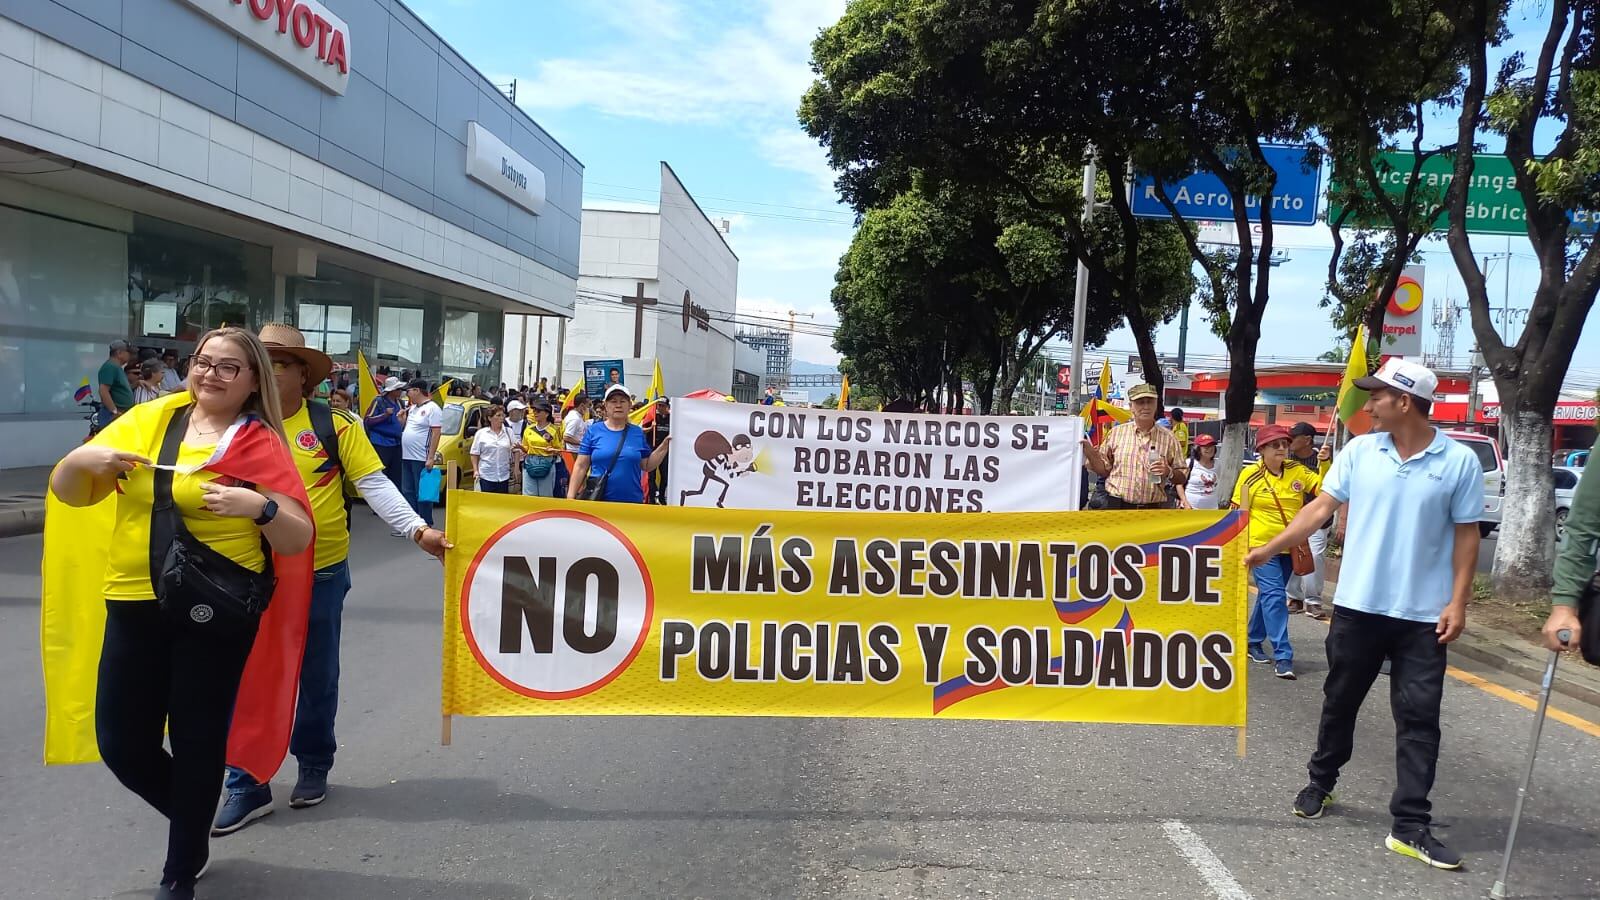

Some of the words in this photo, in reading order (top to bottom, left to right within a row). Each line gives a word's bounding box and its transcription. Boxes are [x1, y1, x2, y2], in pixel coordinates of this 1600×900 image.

[229, 0, 347, 74] YOTA
[501, 156, 527, 190] Distoyota
[1173, 186, 1303, 211] Aerourto
[1465, 200, 1528, 220] ábrica
[749, 410, 806, 439] CON
[817, 415, 872, 443] LOS
[883, 418, 1000, 449] NARCOS
[1011, 423, 1049, 451] SE
[1553, 405, 1596, 420] RVICIO
[793, 446, 933, 479] ROBARON
[943, 454, 1000, 483] LAS
[692, 524, 813, 593] MÁS
[828, 539, 1144, 601] ASESINATOS
[1160, 547, 1220, 603] DE
[499, 556, 619, 654] NO
[661, 620, 899, 682] POLICIAS
[918, 626, 948, 682] Y
[965, 626, 1232, 690] SOLDADOS
